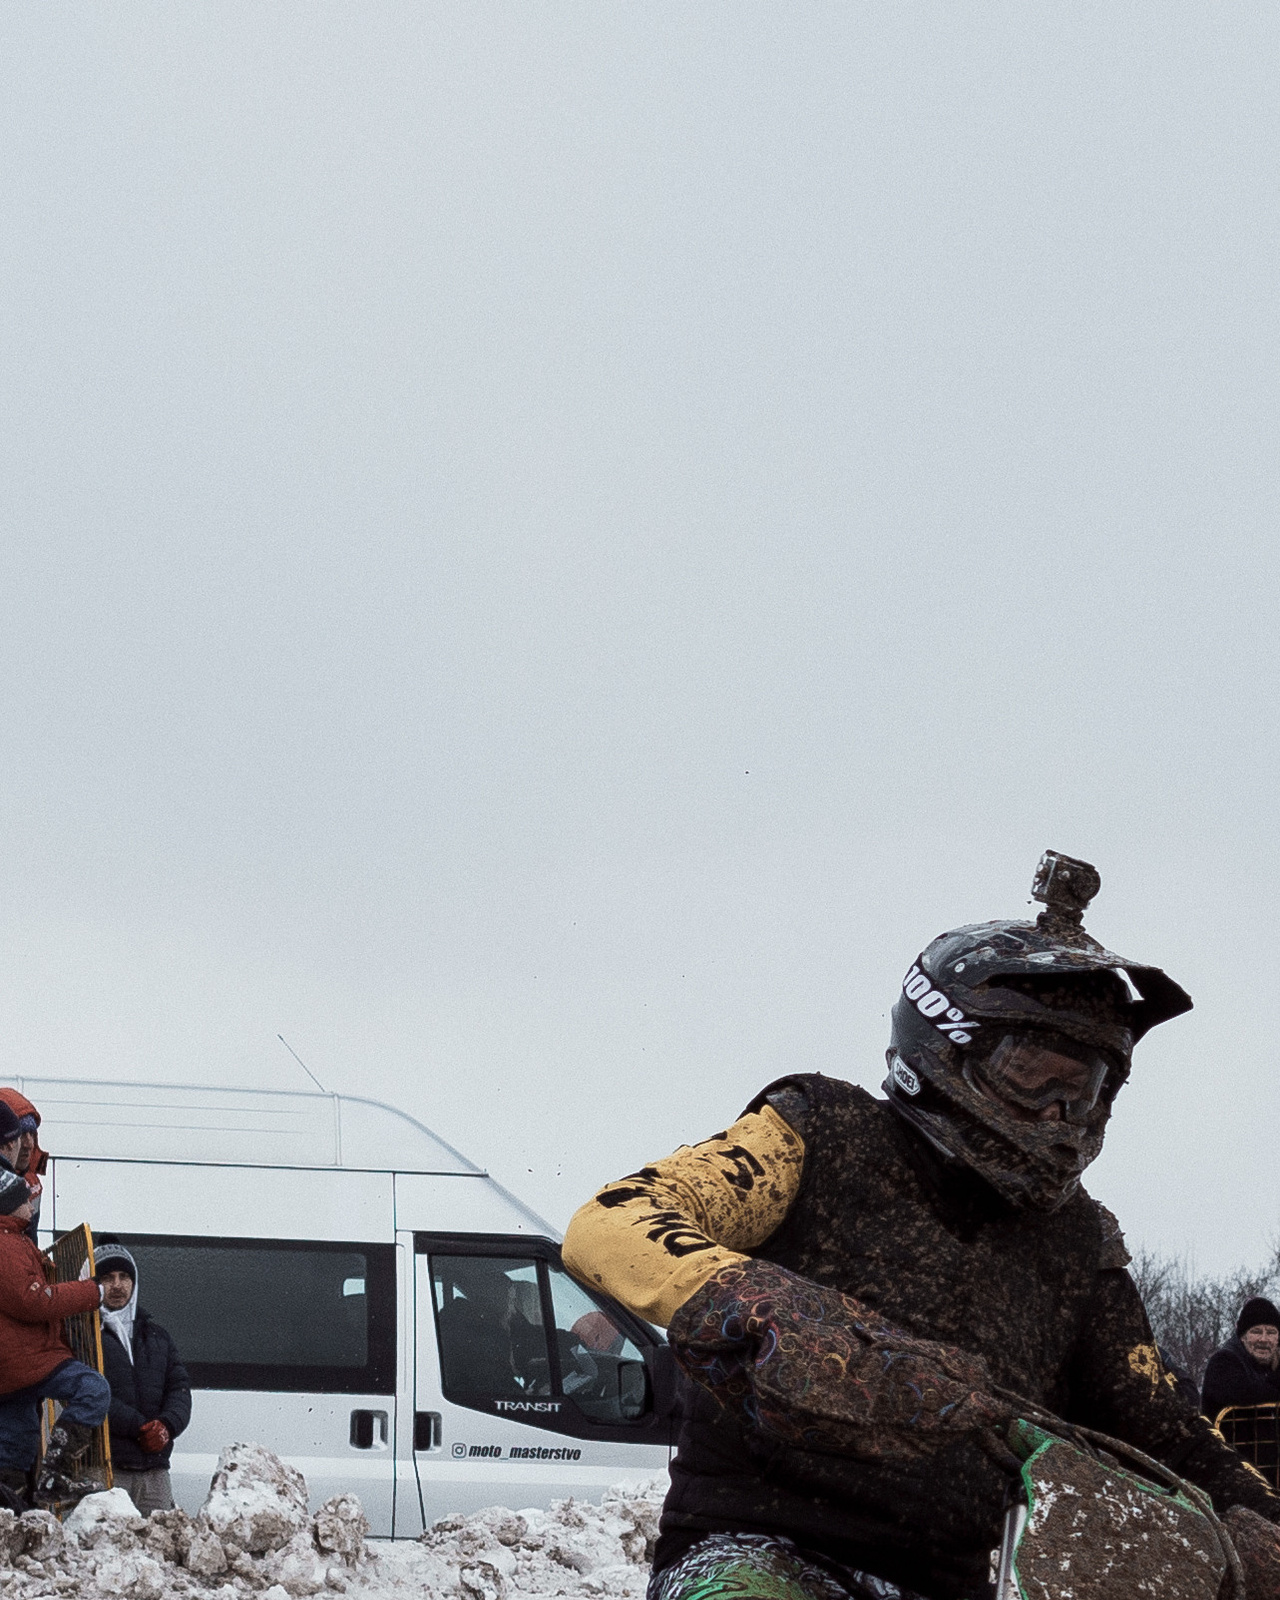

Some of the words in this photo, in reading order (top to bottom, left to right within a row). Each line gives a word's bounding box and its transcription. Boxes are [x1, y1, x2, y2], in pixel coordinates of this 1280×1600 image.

[904, 965, 981, 1044] 100%
[494, 1400, 562, 1413] TRANSIT
[468, 1445, 582, 1461] moto_masterstvo
